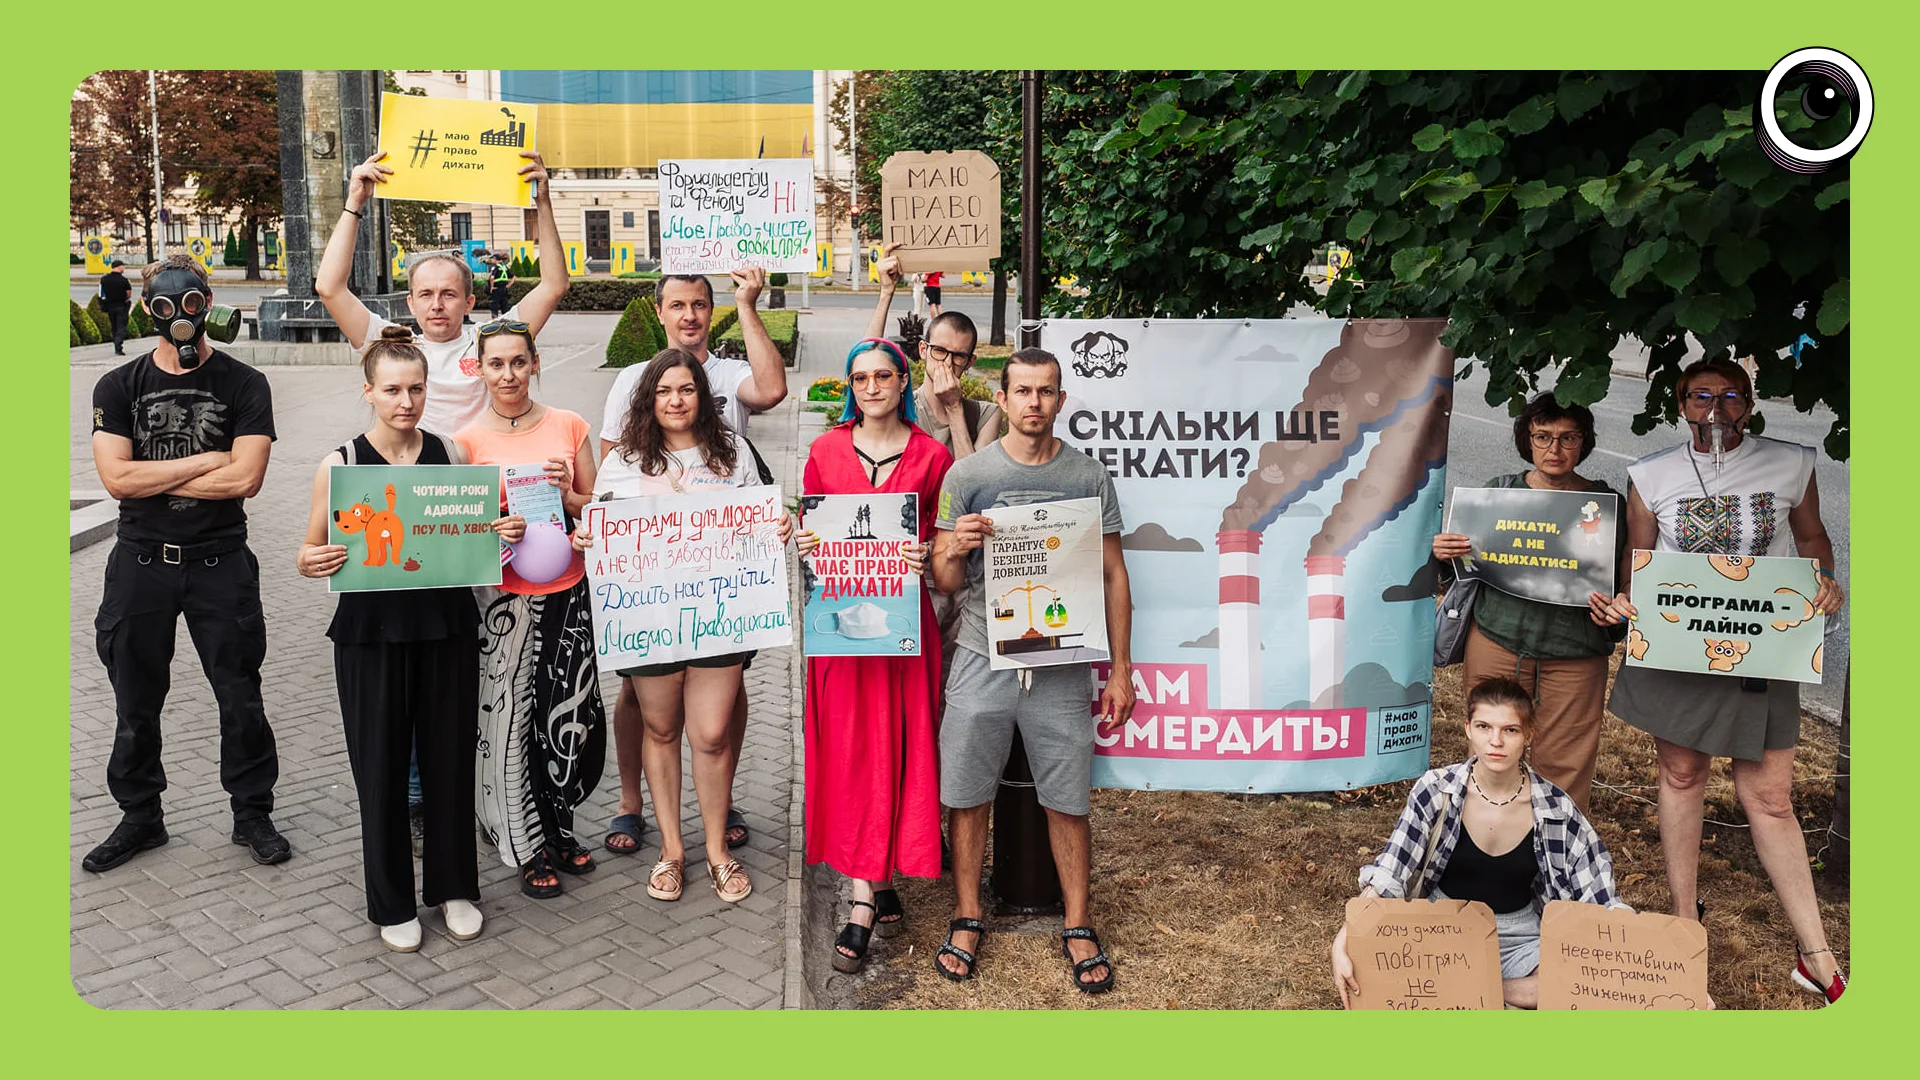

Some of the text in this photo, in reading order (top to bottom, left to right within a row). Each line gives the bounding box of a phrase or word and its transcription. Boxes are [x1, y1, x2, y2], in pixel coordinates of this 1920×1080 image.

[444, 132, 470, 141] маю
[444, 146, 478, 156] право
[442, 161, 485, 171] дихати
[908, 166, 968, 188] МАЮ
[668, 194, 685, 208] та
[891, 194, 982, 221] ПРАВО
[700, 240, 723, 258] 50
[1068, 410, 1340, 444] СКІЛЬКИ ЩЕ
[412, 484, 489, 497] ЧОТИРИ РОКИ
[424, 501, 484, 518] АДВОКАЦІЇ
[412, 524, 436, 535] ПСУ
[440, 524, 460, 536] ПІД
[1495, 519, 1560, 535] ДИХАТИ,
[992, 539, 1046, 553] ГАРАНТУЄ
[1512, 538, 1546, 550] А НЕ
[993, 552, 1048, 566] БЕЗПЕЧНЕ
[1480, 552, 1578, 570] ЗАДИХАТИСЯ
[610, 554, 628, 574] не
[628, 552, 658, 583] для
[816, 560, 909, 575] МАЄ ПРАВО
[992, 565, 1048, 580] ДОВКІЛЛЯ
[596, 558, 776, 612] Досить нас труїти!
[822, 577, 904, 602] ДИХАТИ
[1656, 594, 1774, 614] ПРОГРАМА
[1687, 616, 1763, 636] ЛАЙНО
[599, 618, 672, 658] Маємо
[1384, 710, 1418, 724] #маю
[1092, 714, 1350, 754] СМЕРДИТЬ!
[1384, 723, 1418, 738] право
[1384, 734, 1422, 750] дихати
[1376, 924, 1462, 942] хочу дихати
[1581, 965, 1667, 986] програмам
